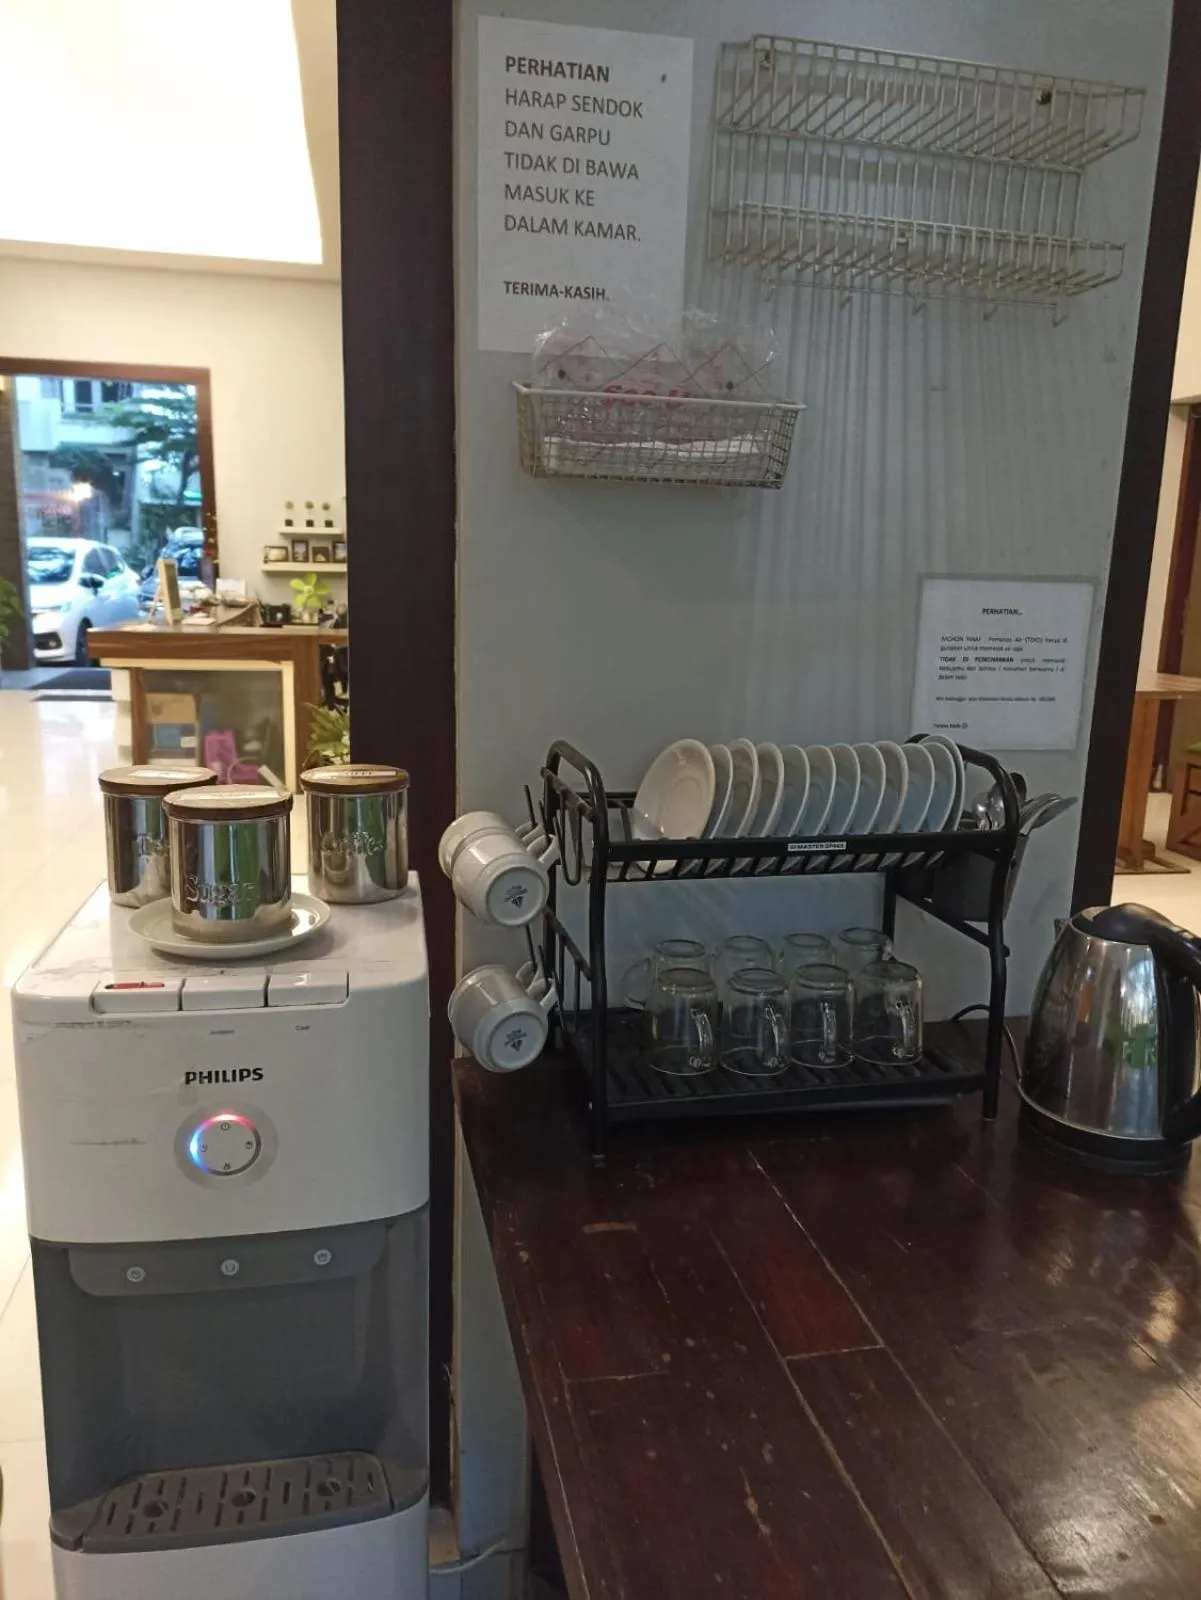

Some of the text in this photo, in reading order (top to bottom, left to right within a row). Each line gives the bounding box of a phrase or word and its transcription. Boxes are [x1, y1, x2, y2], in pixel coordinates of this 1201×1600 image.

[505, 55, 610, 83] PERHATIAN
[505, 88, 644, 118] HARAP SENDOK
[505, 120, 611, 146] DAN GARPU
[504, 151, 640, 180] TIDAK DI BAWA
[504, 183, 596, 207] MASUK KE
[504, 214, 641, 242] DALAM KAMAR.
[504, 280, 610, 302] TERIMA-KASIH.
[184, 1067, 264, 1086] PHILIPS
